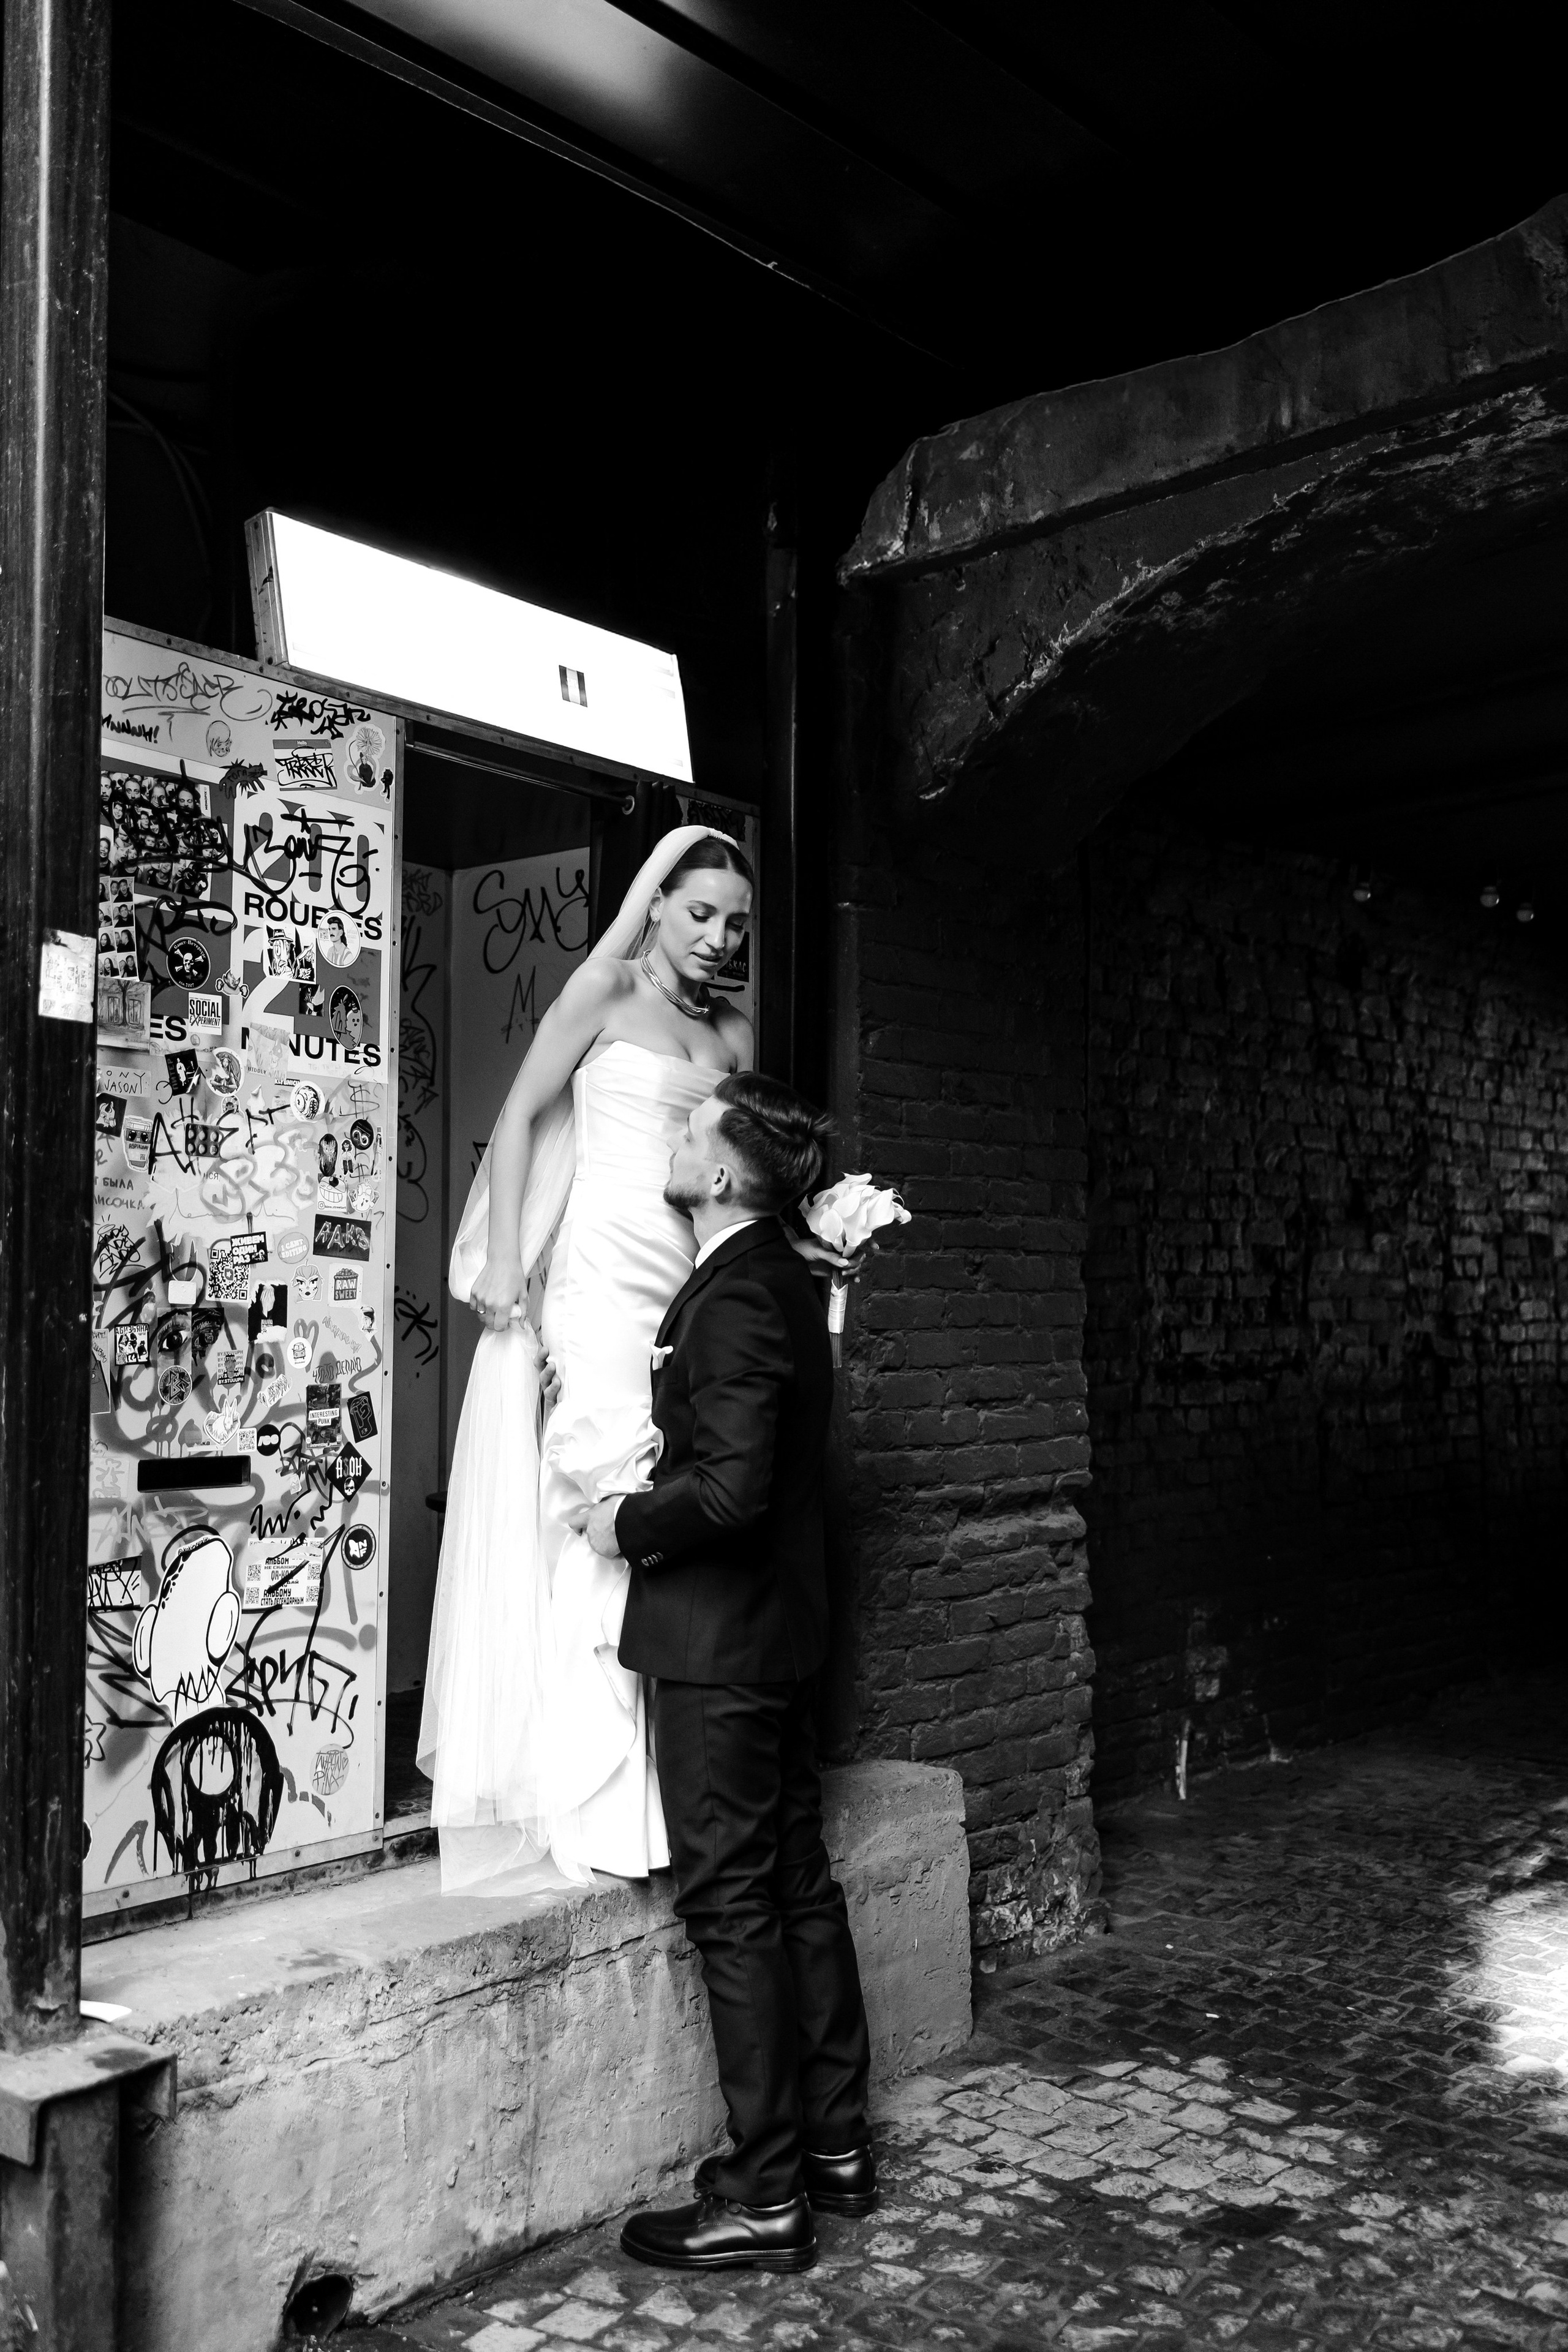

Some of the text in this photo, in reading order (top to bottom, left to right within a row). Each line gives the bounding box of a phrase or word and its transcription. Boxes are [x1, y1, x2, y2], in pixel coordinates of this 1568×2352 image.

[190, 999, 221, 1017] SOCIAL
[189, 1015, 221, 1027] EXPERIMENT
[241, 1027, 382, 1067] NUTES
[102, 1177, 134, 1191] БЫЛА
[232, 1234, 264, 1247] ЖИВЕМ
[232, 1244, 257, 1256] ОДИН
[233, 1254, 251, 1265] РАЗ
[336, 1278, 356, 1289] RAW
[335, 1289, 356, 1300] SWEET
[310, 1410, 338, 1419] INTERESTING
[260, 1597, 304, 1606] СТАТЬ ЛЕГЕНДАРНЫМ
